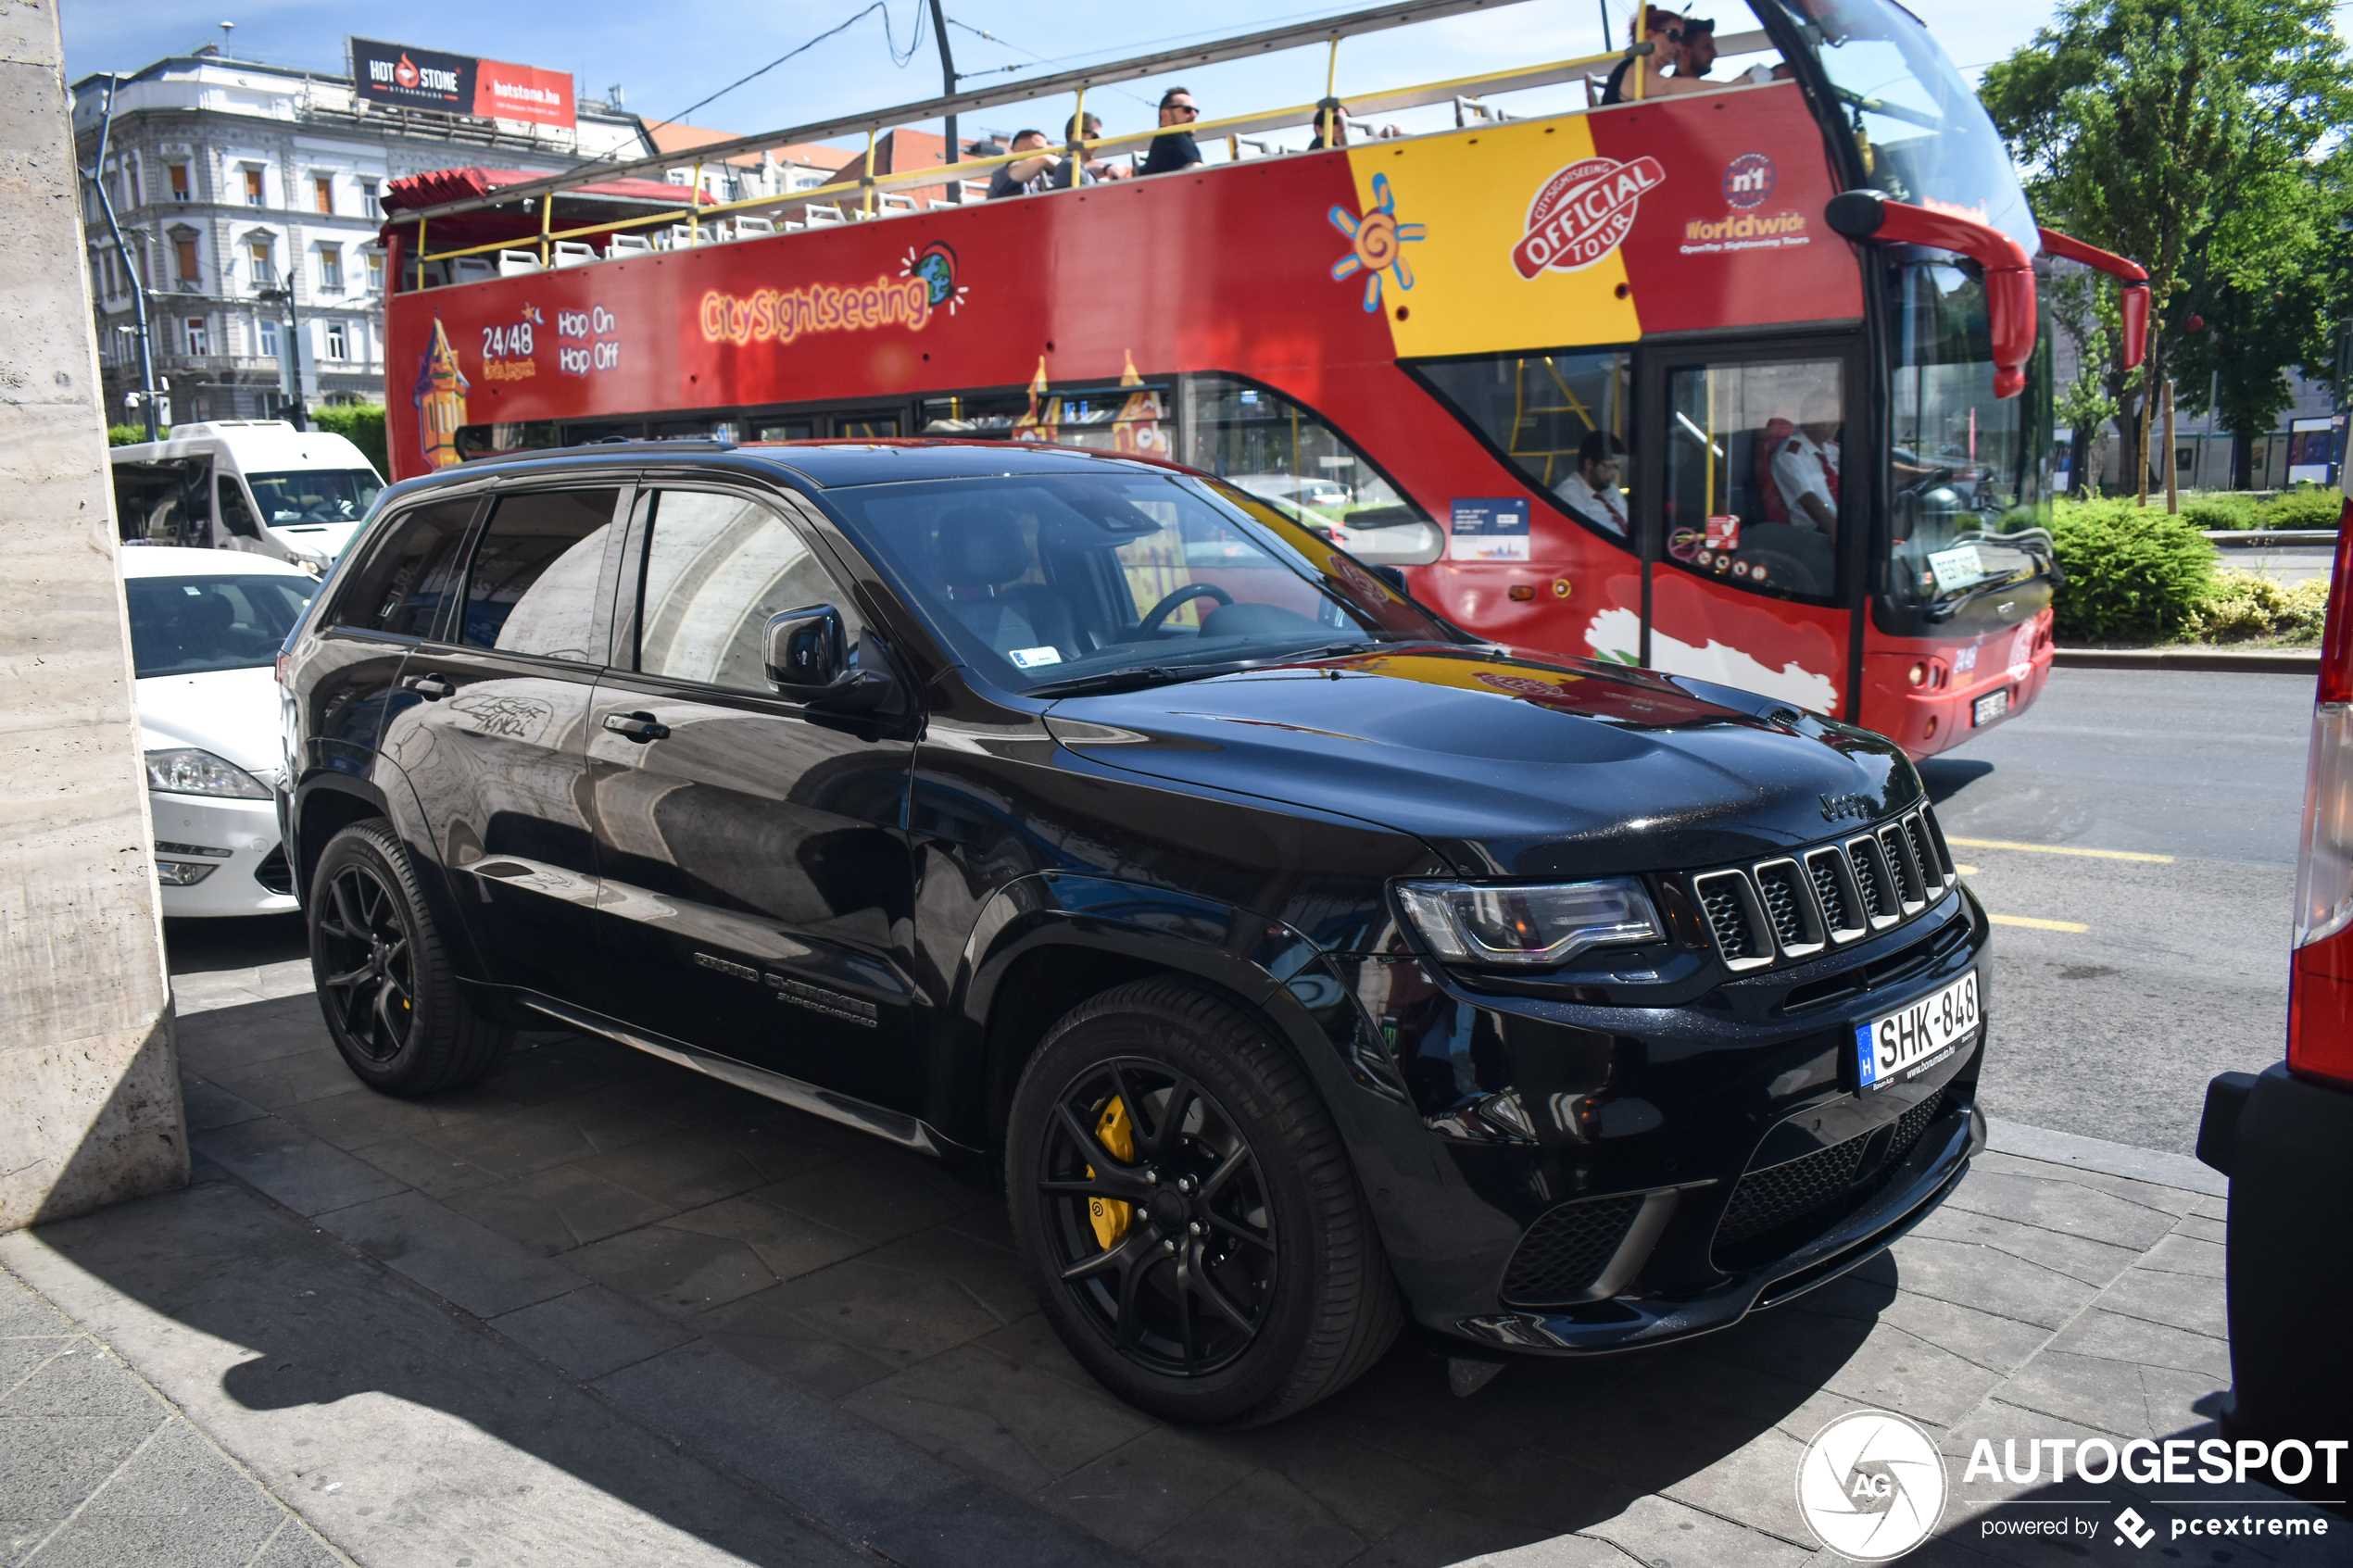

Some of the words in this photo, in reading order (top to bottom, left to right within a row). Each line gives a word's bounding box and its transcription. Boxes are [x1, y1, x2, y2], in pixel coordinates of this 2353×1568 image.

[370, 60, 395, 82] HOT
[420, 68, 459, 92] STONE
[494, 79, 560, 105] hotstone.hu
[1533, 162, 1610, 220] CITYSIGHTSEEING
[1526, 165, 1656, 266] OFFICIAL
[1686, 211, 1806, 240] Worldwide
[1572, 213, 1630, 263] TOUR
[559, 311, 589, 339] Hop
[592, 306, 615, 334] On
[483, 322, 534, 358] 24/48
[560, 347, 591, 374] Hop
[594, 342, 619, 370] Off
[1819, 792, 1869, 823] Jeep
[694, 952, 759, 983] GRAND
[764, 972, 877, 1018] CHEROKEE
[776, 991, 878, 1028] SUPERCHARGED
[1880, 978, 1974, 1069] SHK-848
[1862, 1057, 1871, 1076] H
[1906, 1045, 1956, 1079] www.bonumauto.hu
